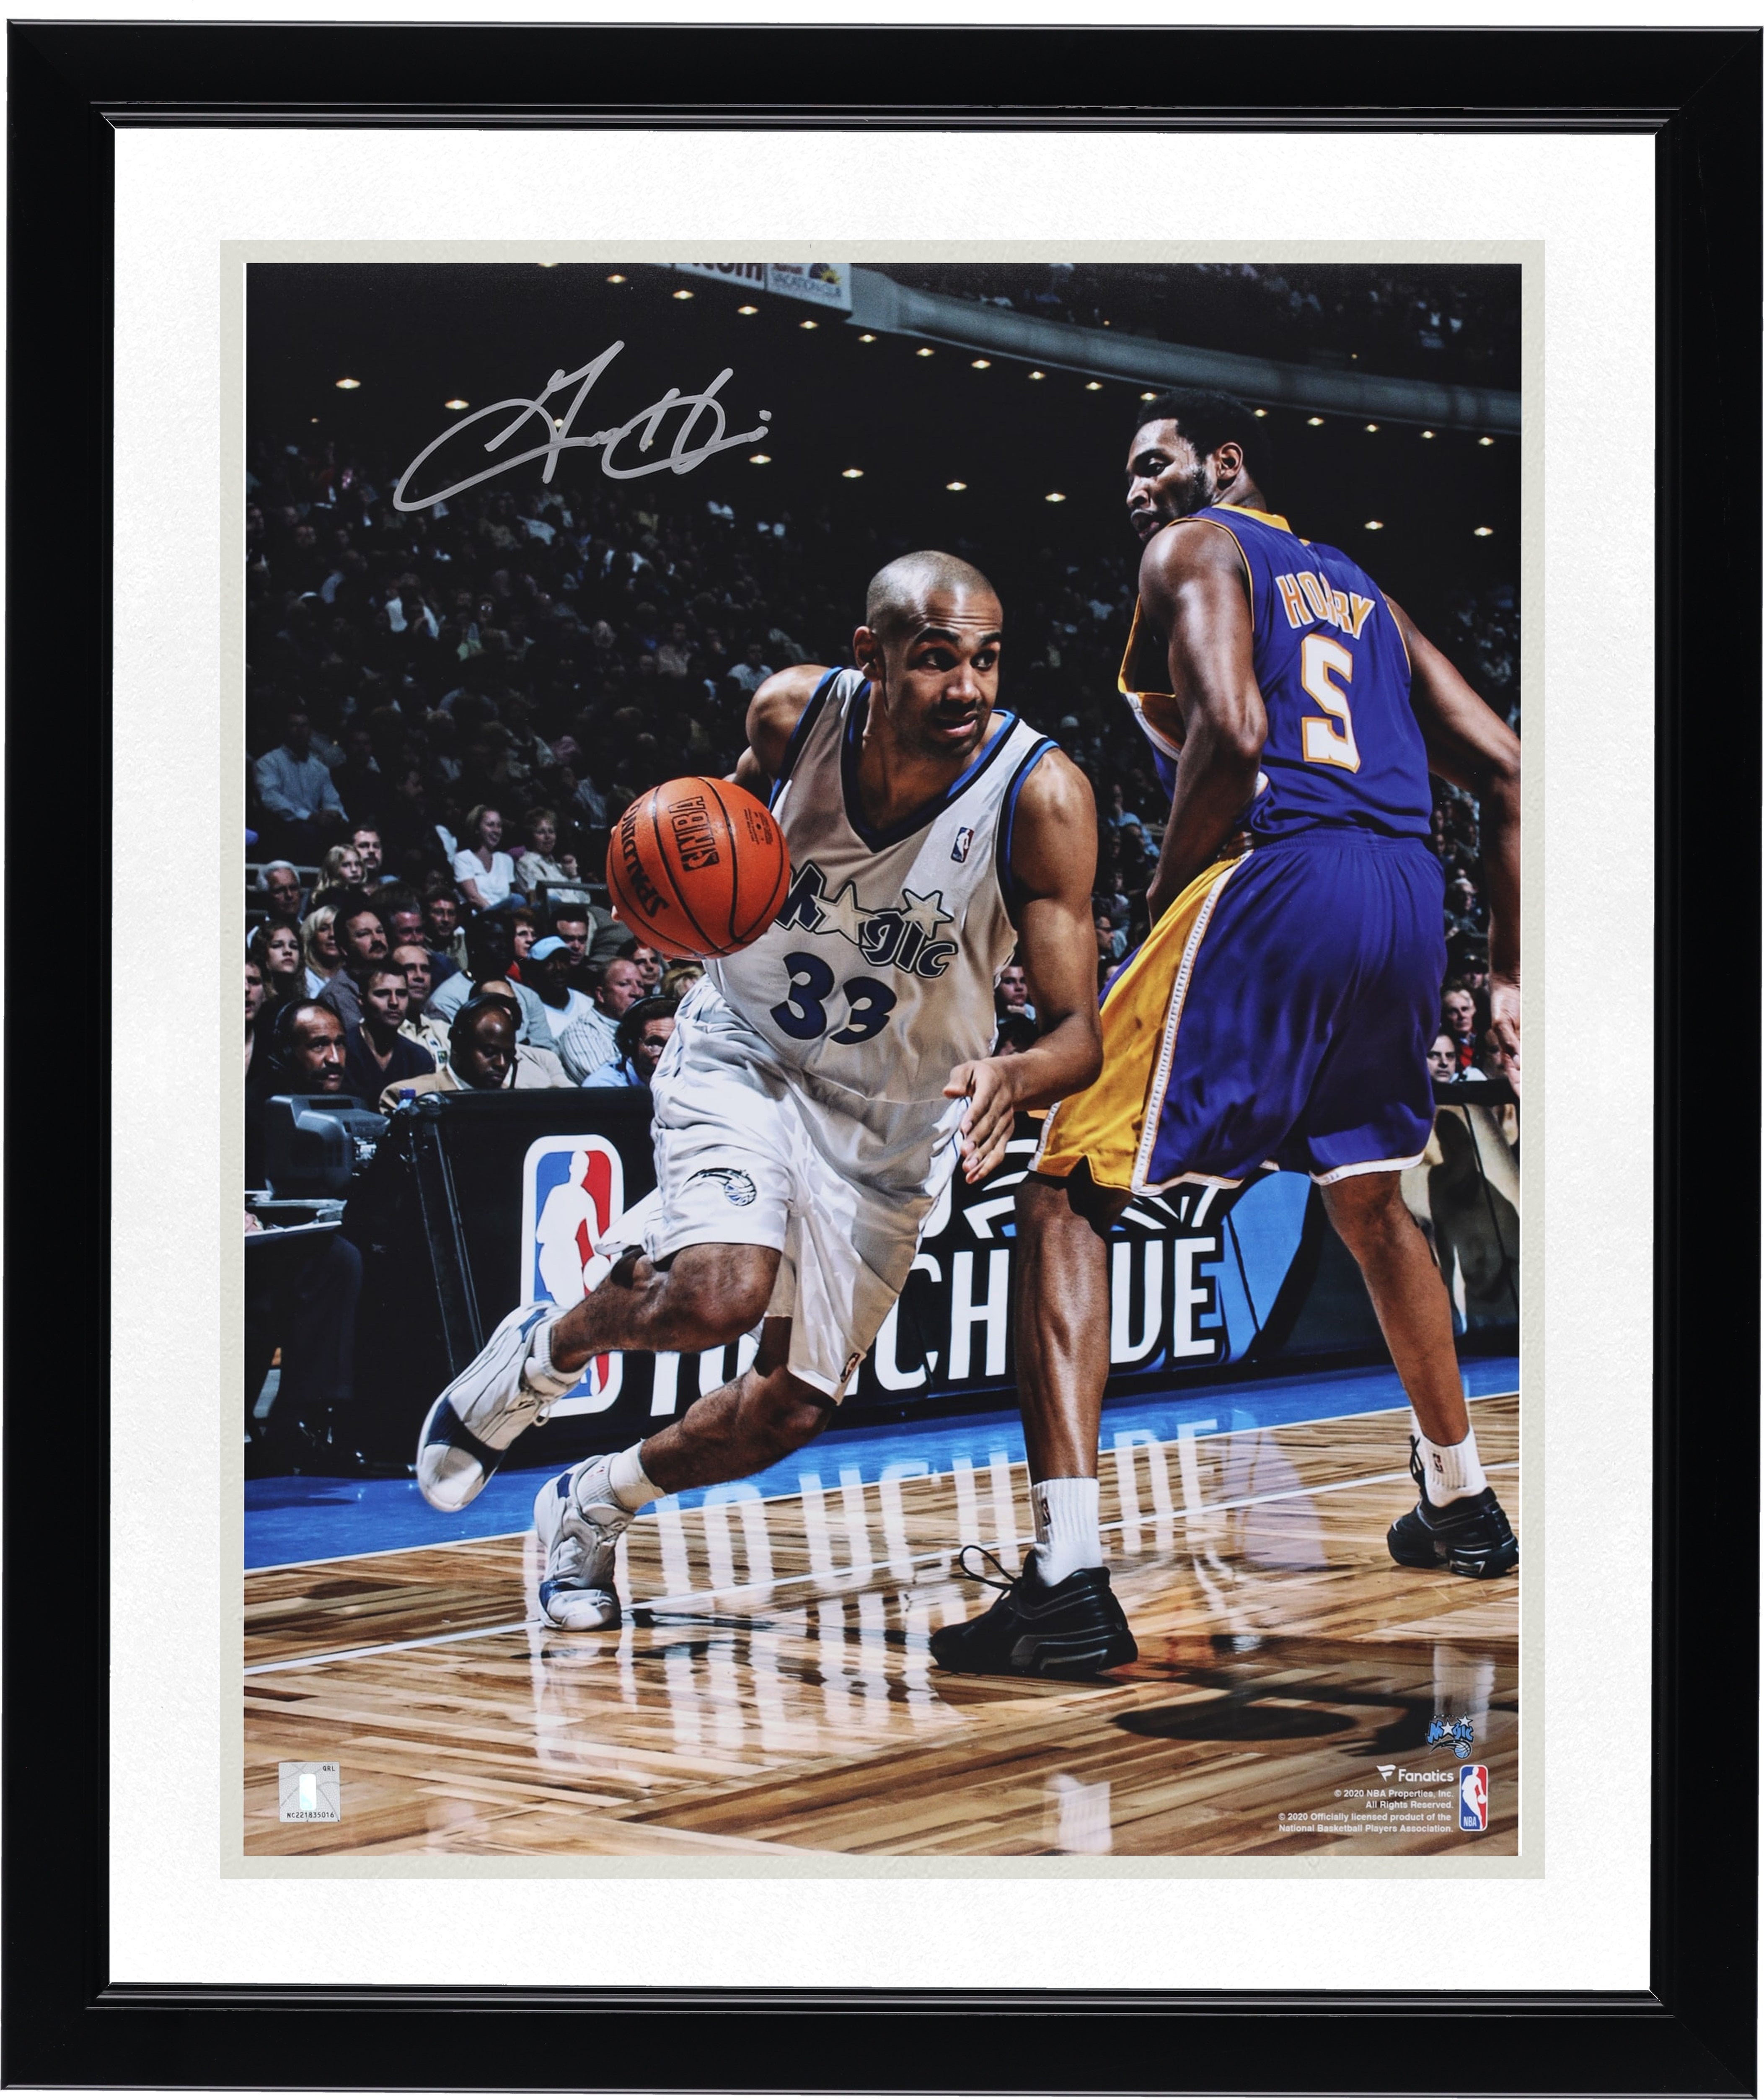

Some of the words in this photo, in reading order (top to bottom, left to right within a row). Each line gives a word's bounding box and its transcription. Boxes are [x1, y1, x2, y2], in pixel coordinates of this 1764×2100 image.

[1301, 633, 1361, 773] 5
[668, 796, 716, 853] NBA
[770, 951, 898, 1044] 33
[1398, 1769, 1454, 1782] Fanatics
[1389, 1789, 1436, 1799] Properties,
[1380, 1800, 1408, 1810] Rights
[1311, 1813, 1349, 1822] Officially
[1390, 1813, 1424, 1822] product
[1463, 1816, 1477, 1827] NBA
[1365, 1824, 1397, 1834] Players
